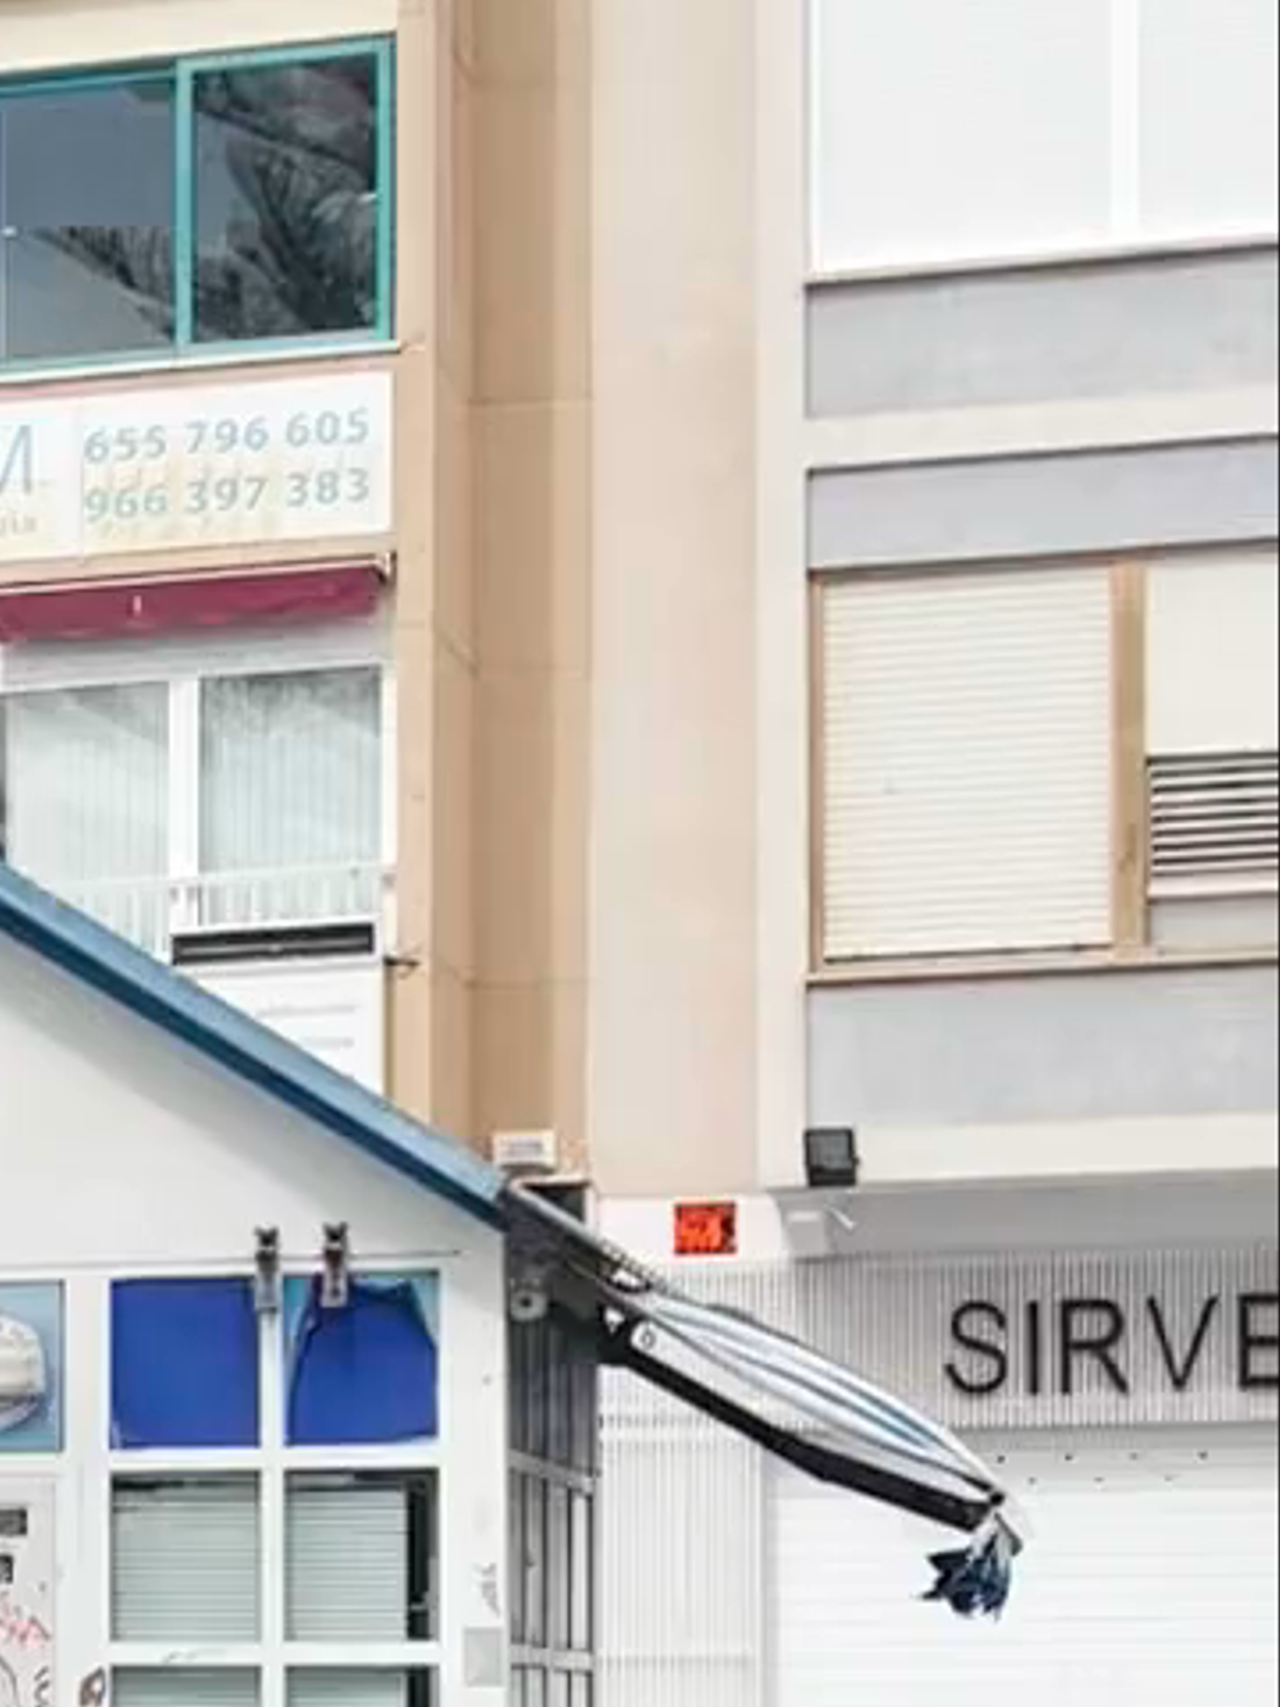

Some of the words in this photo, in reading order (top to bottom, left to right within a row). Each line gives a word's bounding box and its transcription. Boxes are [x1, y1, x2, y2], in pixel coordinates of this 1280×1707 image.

[83, 424, 168, 464] 655
[184, 415, 270, 454] 796
[285, 406, 370, 448] 605
[83, 484, 169, 524] 966
[184, 475, 268, 515] 397
[285, 467, 371, 508] 383
[944, 1294, 1279, 1396] SIRVE
